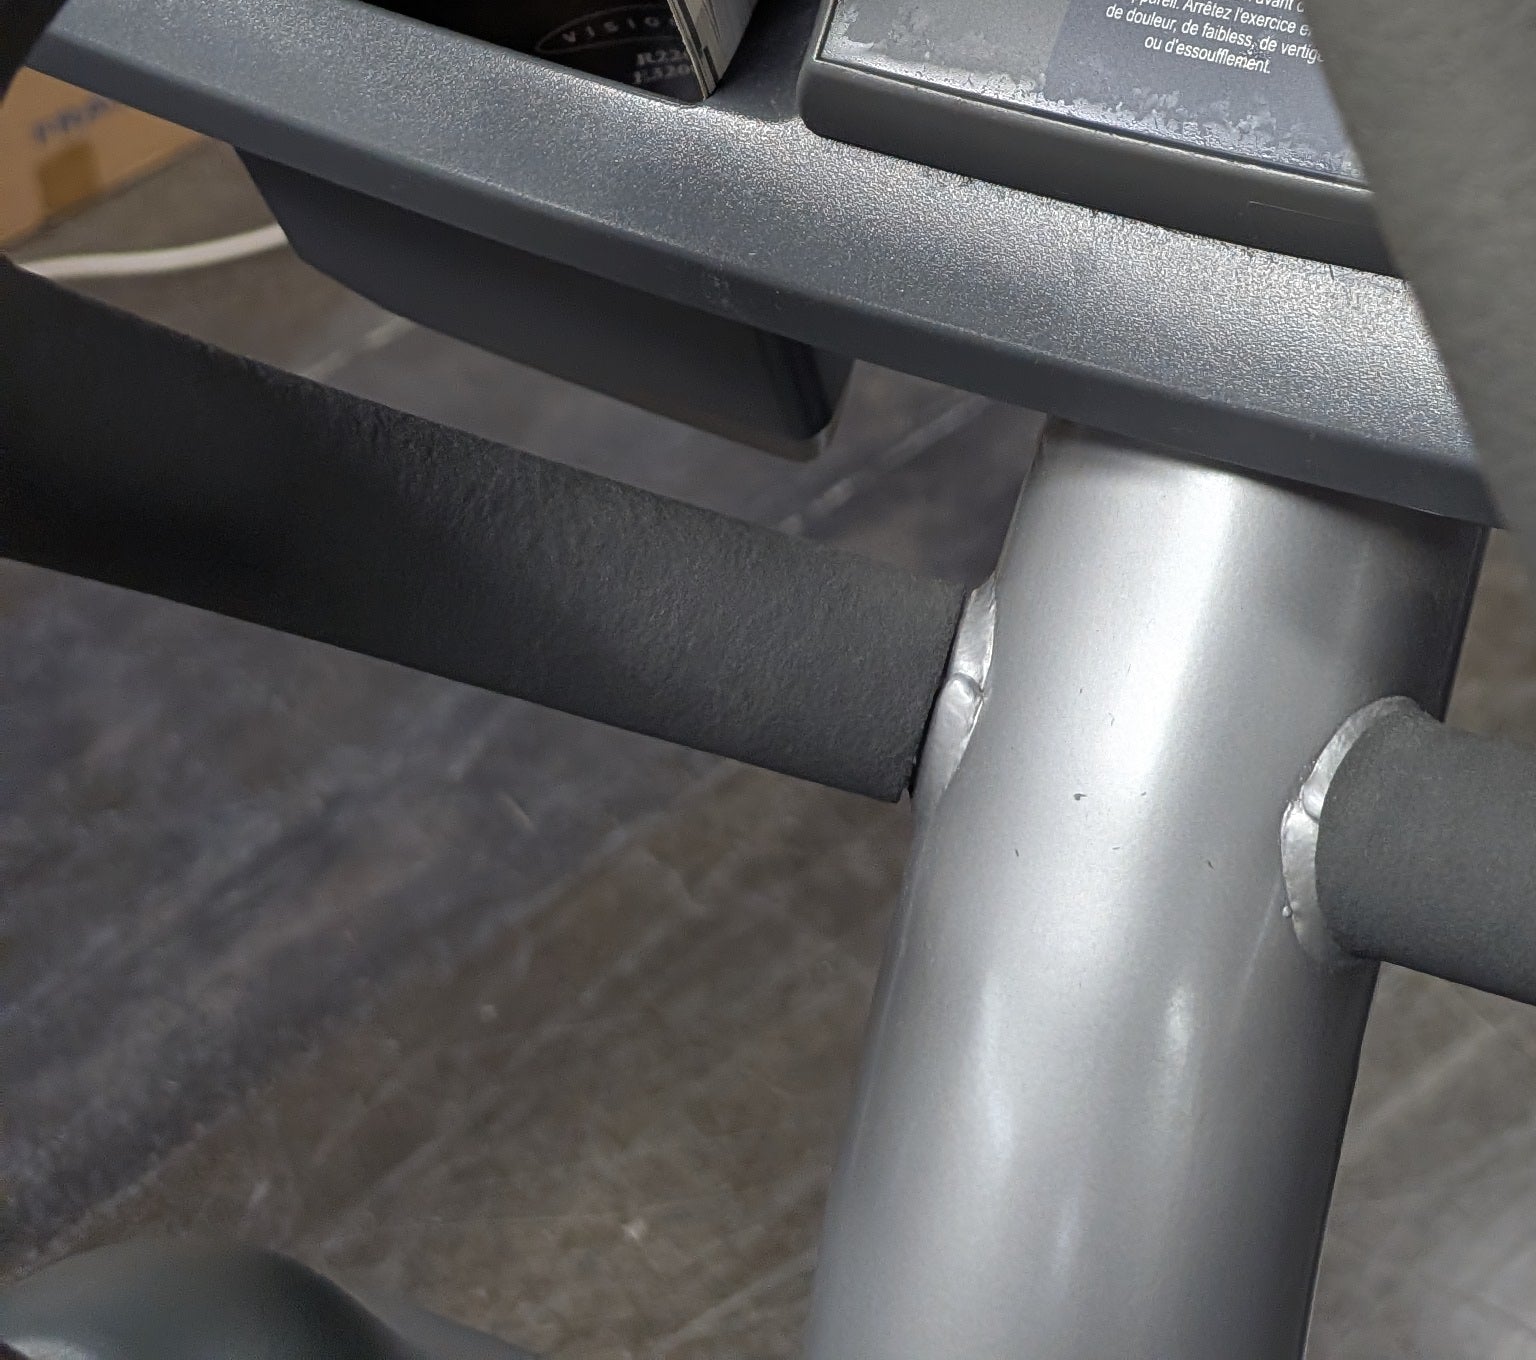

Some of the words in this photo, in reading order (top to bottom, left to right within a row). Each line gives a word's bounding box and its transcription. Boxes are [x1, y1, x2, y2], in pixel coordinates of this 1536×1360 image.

[1105, 4, 1124, 20] de
[1125, 6, 1177, 33] douleur,
[1181, 19, 1200, 36] de
[1201, 22, 1256, 49] faibless,
[1258, 35, 1278, 53] de
[1233, 6, 1297, 34] l'exercice
[1144, 35, 1162, 51] ou
[1164, 37, 1271, 75] d'essoufflement.
